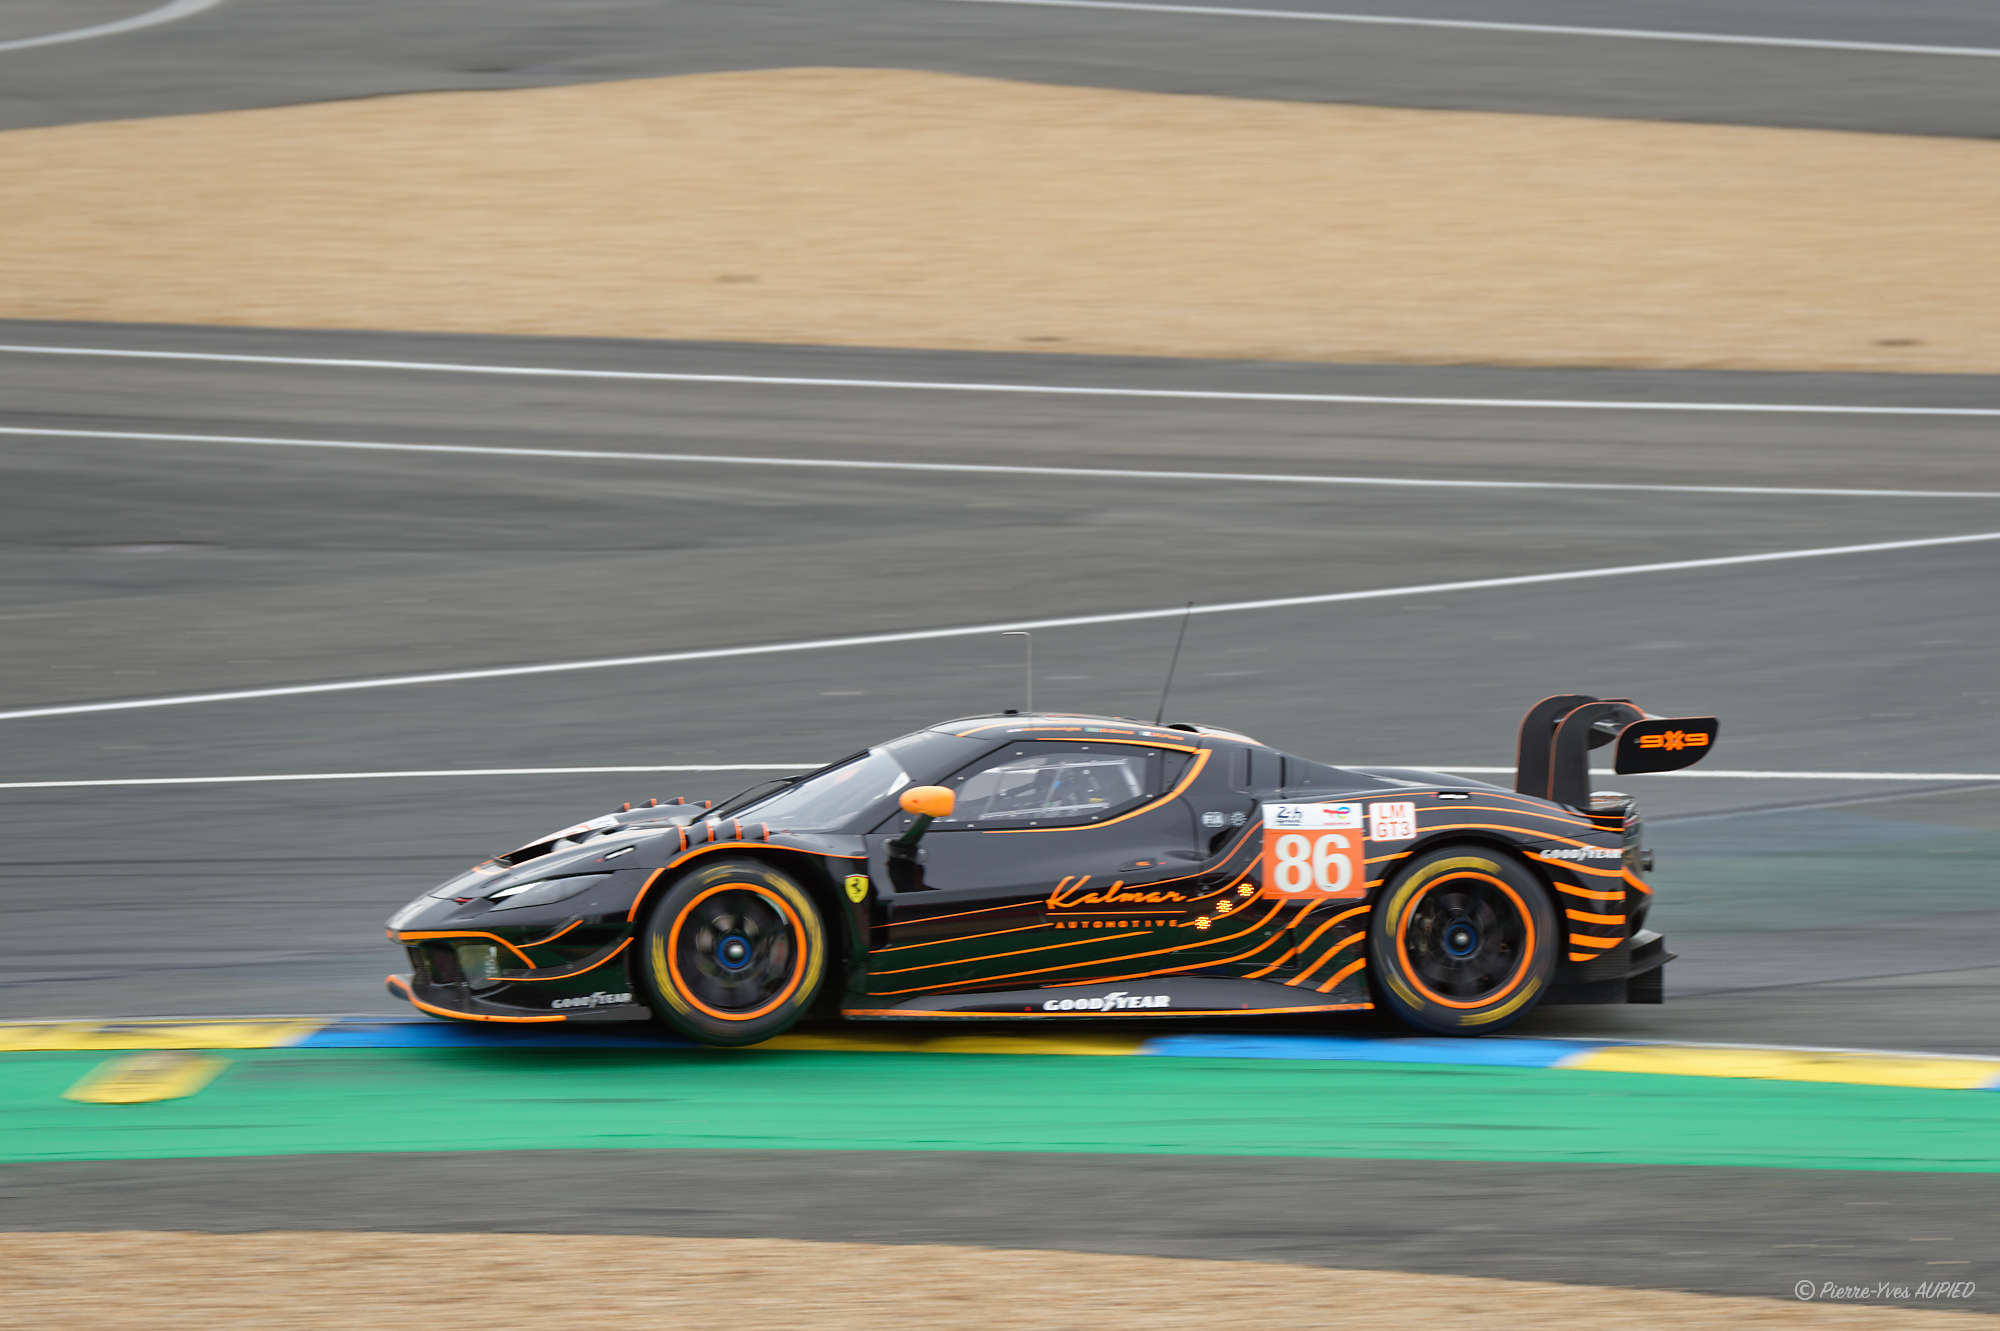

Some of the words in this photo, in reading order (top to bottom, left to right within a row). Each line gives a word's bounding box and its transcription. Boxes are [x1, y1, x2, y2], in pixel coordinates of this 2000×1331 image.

[1378, 805, 1405, 819] LM
[1376, 821, 1411, 838] GT3
[1274, 834, 1351, 892] 86
[1045, 875, 1187, 910] Kalmar
[1054, 919, 1179, 929] AUTOMOTIVE
[1043, 991, 1171, 1012] GOODYEAR
